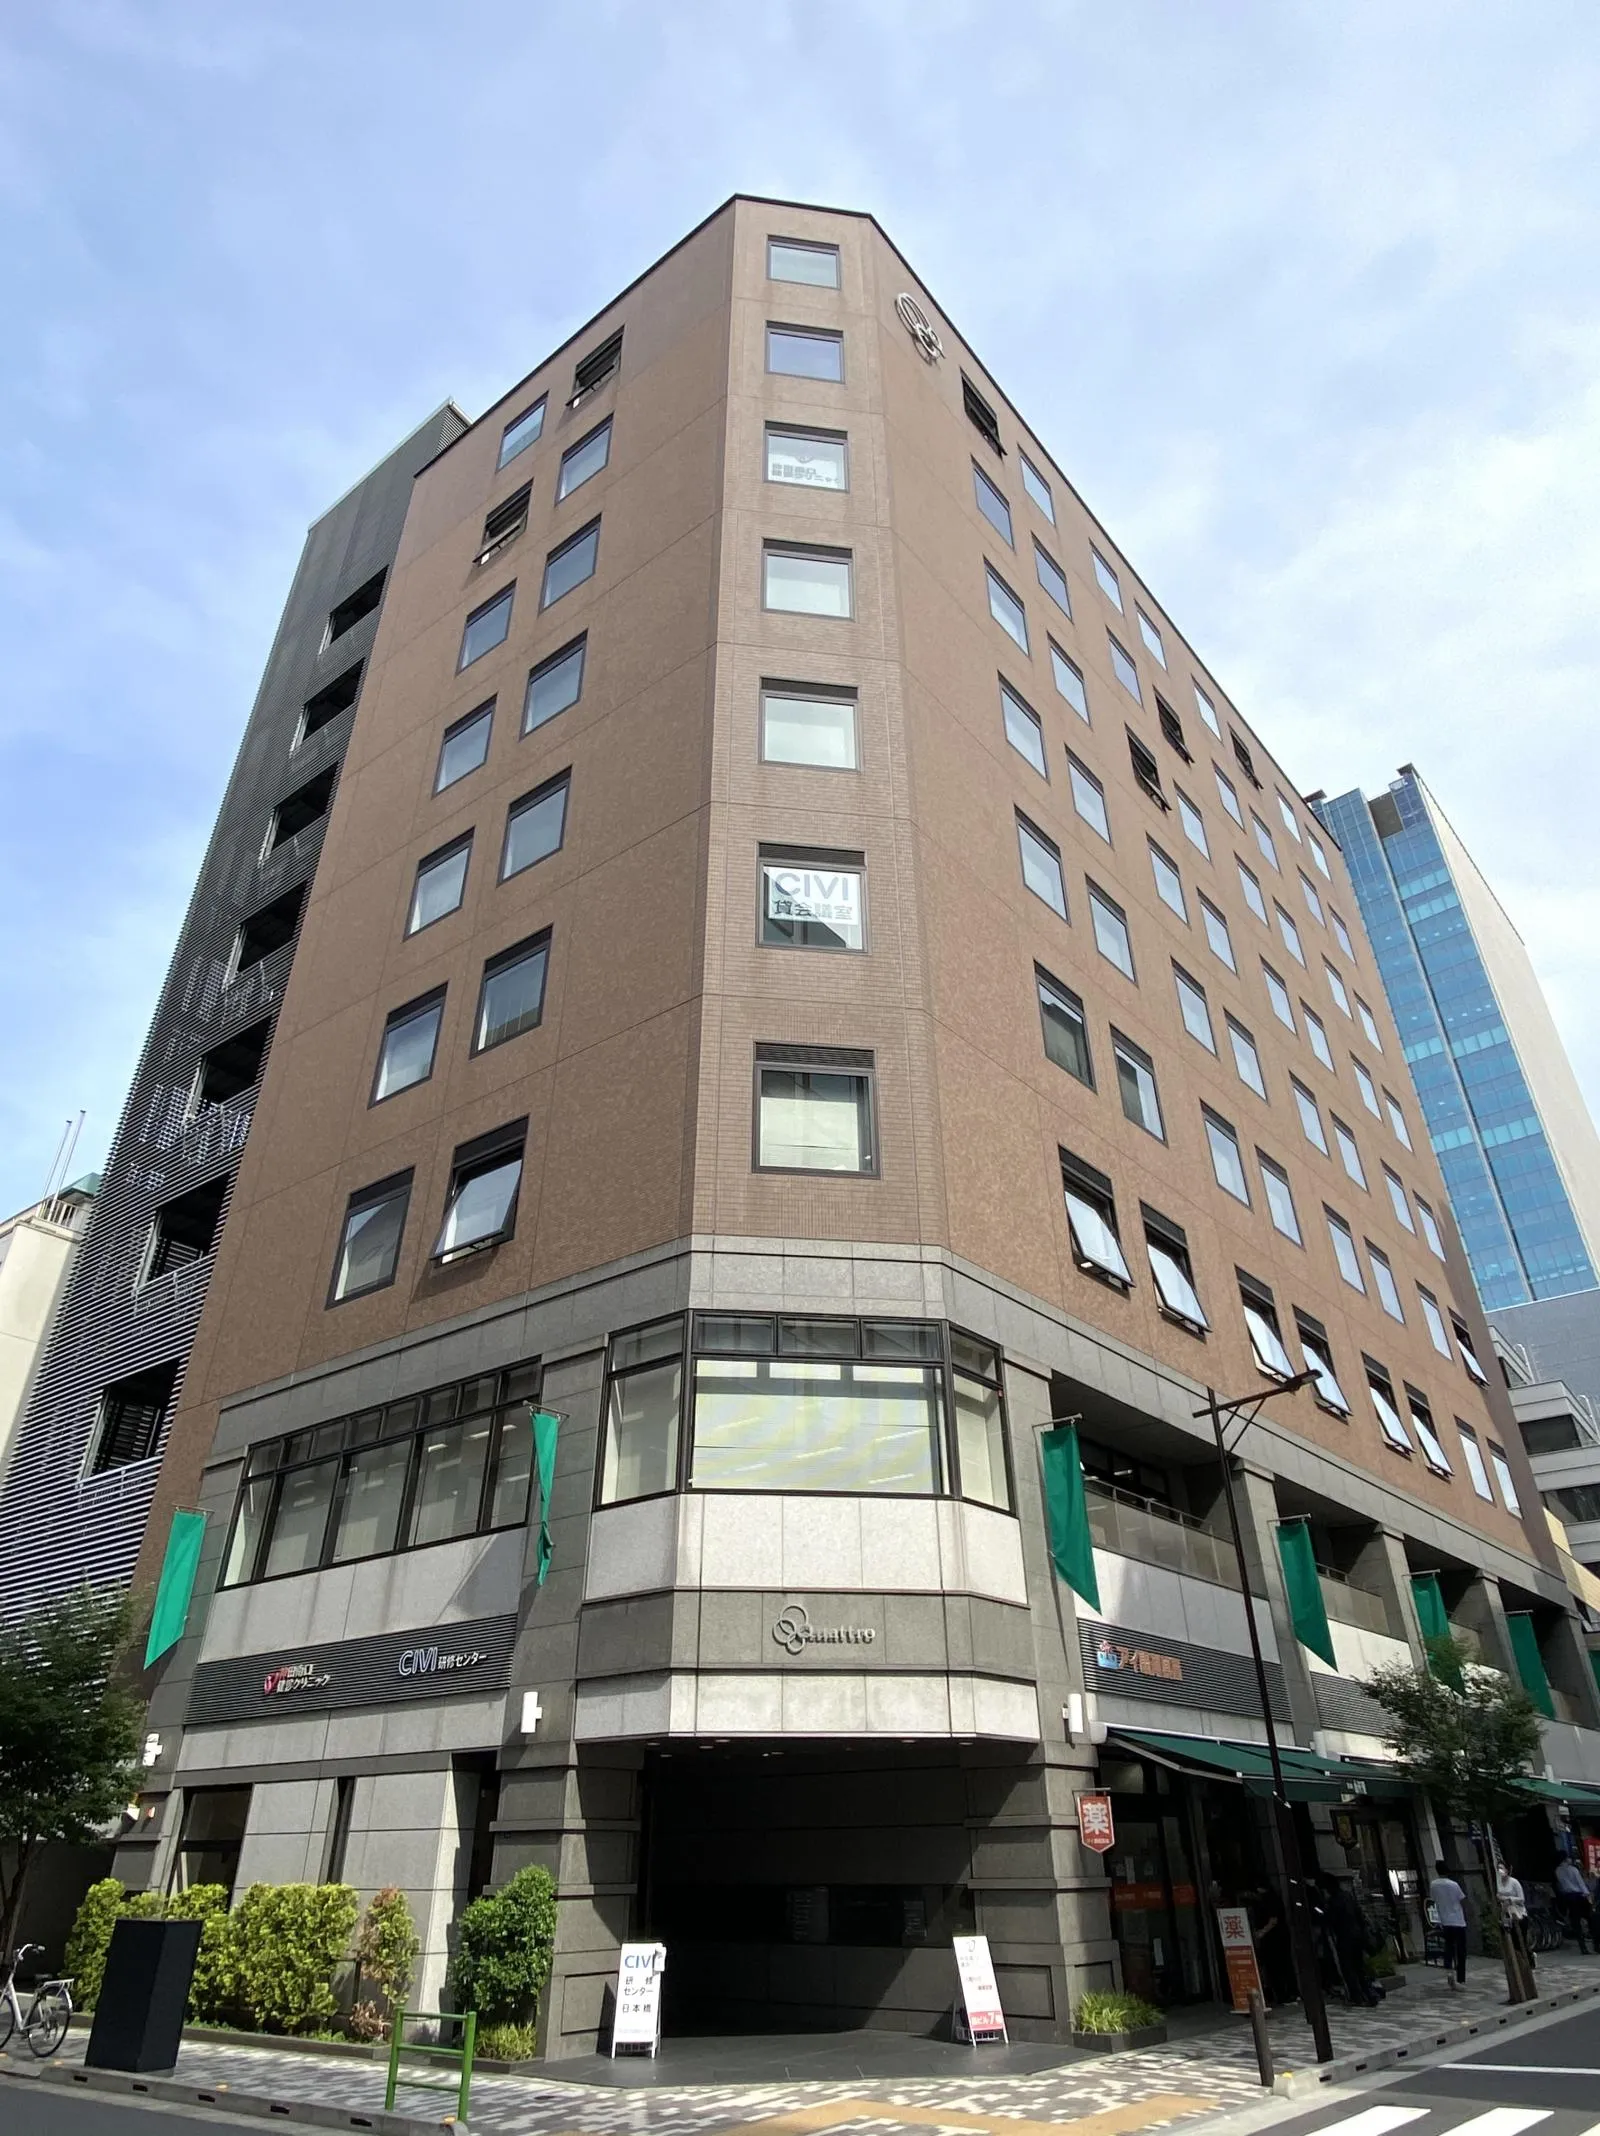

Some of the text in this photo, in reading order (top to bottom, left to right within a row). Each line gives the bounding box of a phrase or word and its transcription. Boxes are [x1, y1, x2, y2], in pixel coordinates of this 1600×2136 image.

[775, 872, 849, 901] CIVI
[398, 1646, 438, 1676] CIVI
[1082, 1802, 1110, 1835] 薬
[1223, 1914, 1246, 1939] 薬
[624, 1954, 652, 1970] CIV
[624, 1986, 654, 1997] センター
